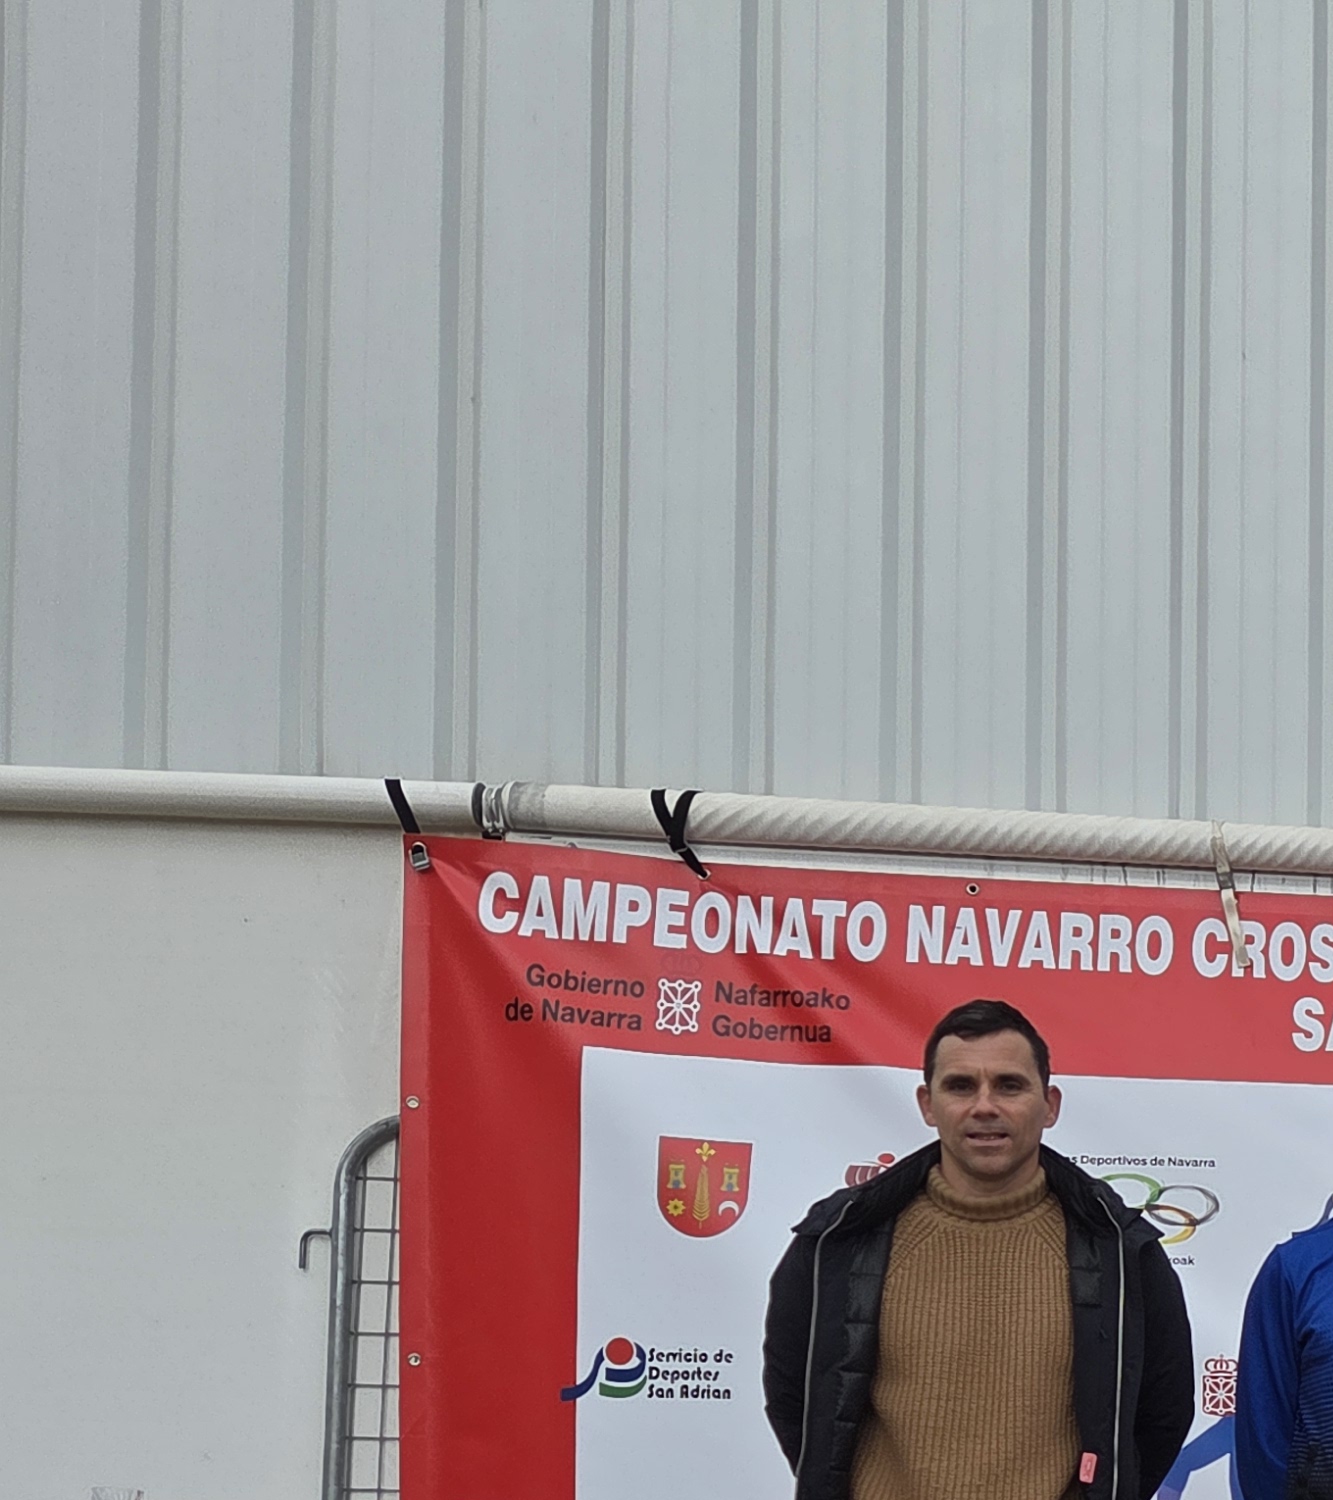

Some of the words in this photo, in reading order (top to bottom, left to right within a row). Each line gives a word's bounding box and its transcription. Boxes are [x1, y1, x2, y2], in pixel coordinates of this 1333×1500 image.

[478, 870, 888, 963] CAMPEONATO
[906, 904, 1174, 976] NAVARRO
[525, 963, 645, 999] Gobierno
[714, 980, 851, 1011] Nafarroako
[505, 997, 534, 1022] de
[541, 999, 642, 1031] Navarra
[712, 1014, 832, 1043] Gobernua
[1080, 1155, 1148, 1167] Deportivos
[1150, 1155, 1165, 1167] de
[1168, 1157, 1217, 1168] Navarra
[713, 1349, 734, 1364] de
[648, 1366, 720, 1384] Deportes
[647, 1384, 674, 1399] San
[679, 1384, 732, 1400] Adrian
